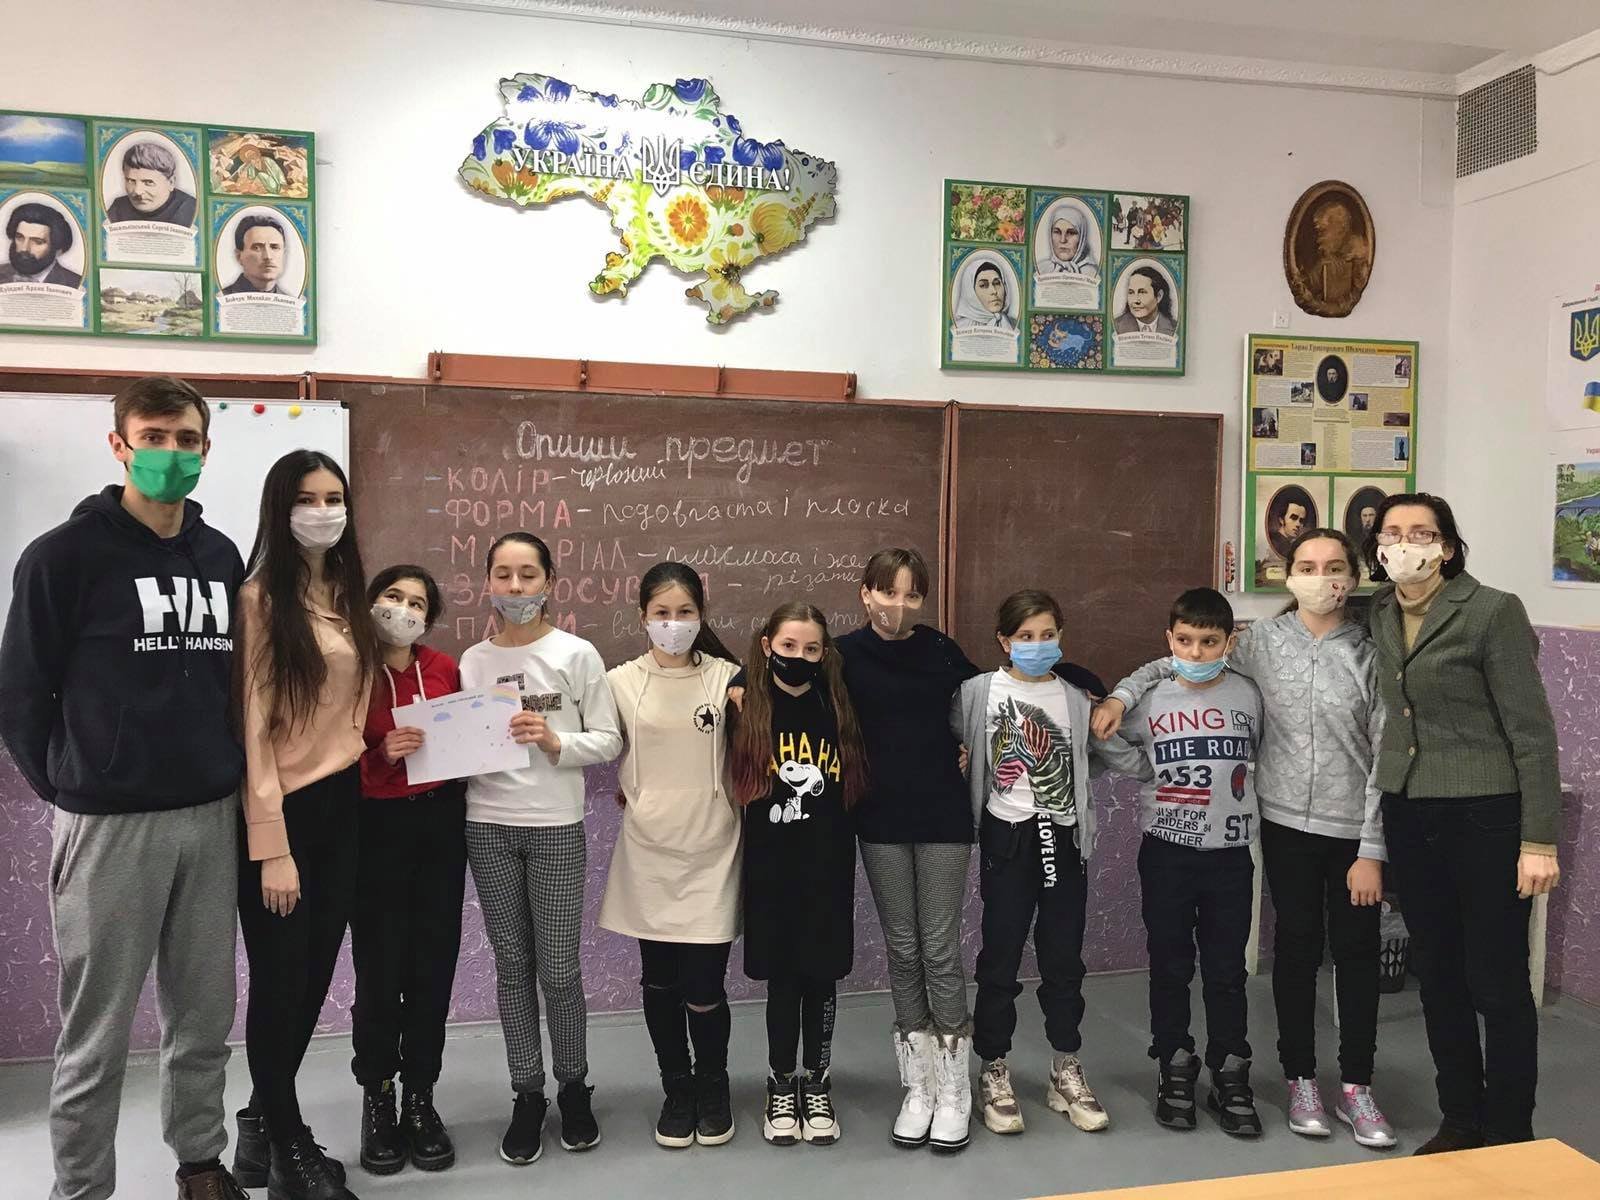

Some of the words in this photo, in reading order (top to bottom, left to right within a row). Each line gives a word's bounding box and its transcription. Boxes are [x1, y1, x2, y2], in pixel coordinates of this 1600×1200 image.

[512, 146, 634, 180] УКРАЇНА
[689, 160, 791, 191] ЄДИНА!
[516, 420, 637, 461] Опиши
[665, 435, 832, 483] предмет
[445, 498, 572, 529] ФОРМА
[806, 498, 910, 519] плоска
[1148, 708, 1225, 737] KING
[1158, 740, 1195, 761] THE
[1158, 764, 1212, 789] 153
[1157, 817, 1199, 831] RIDERS
[1183, 809, 1207, 821] FOR
[1224, 812, 1253, 842] ST
[1151, 828, 1203, 847] PANTHER
